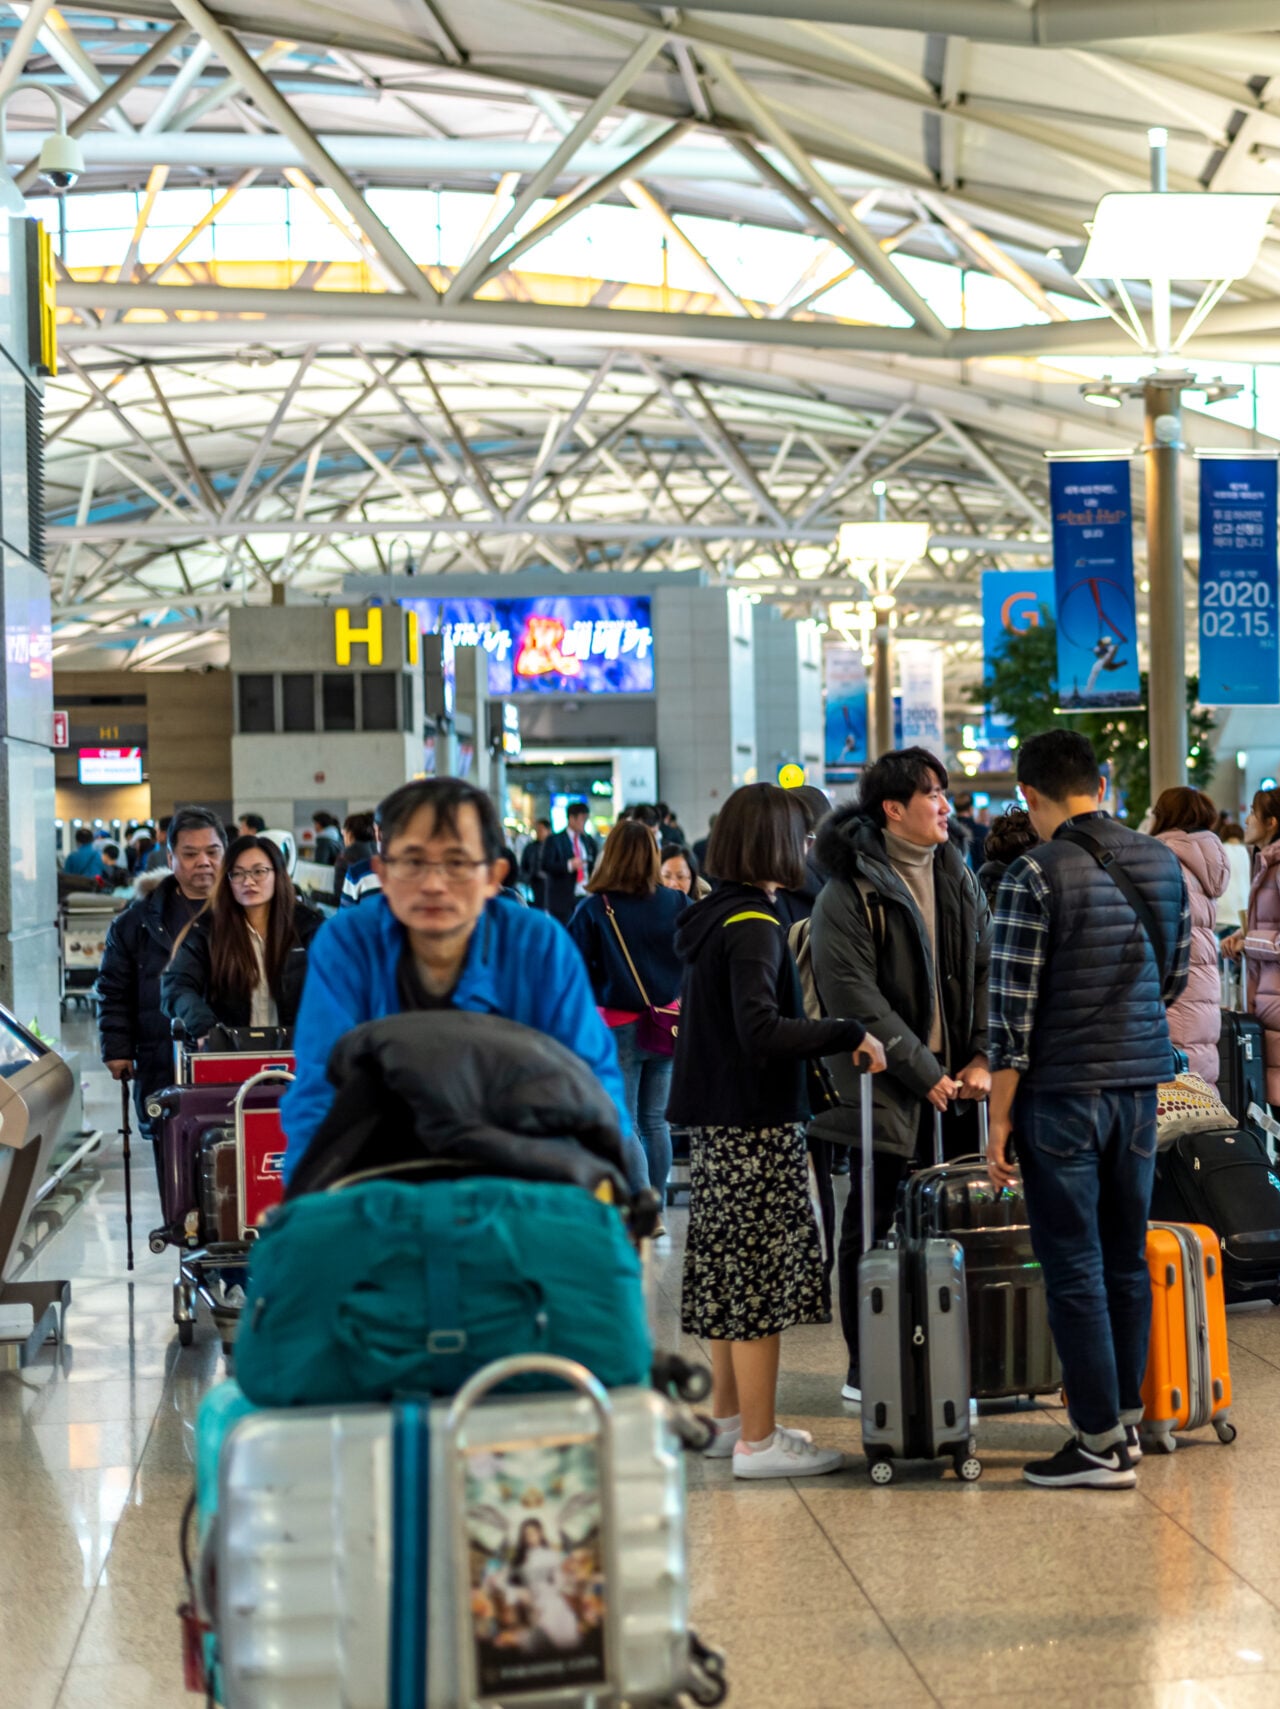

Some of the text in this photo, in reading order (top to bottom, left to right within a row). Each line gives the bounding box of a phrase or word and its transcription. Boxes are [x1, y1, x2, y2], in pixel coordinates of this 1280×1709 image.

[1203, 581, 1275, 608] 2020.
[1001, 591, 1039, 637] G
[1202, 611, 1275, 637] 02.15.
[335, 607, 383, 666] H
